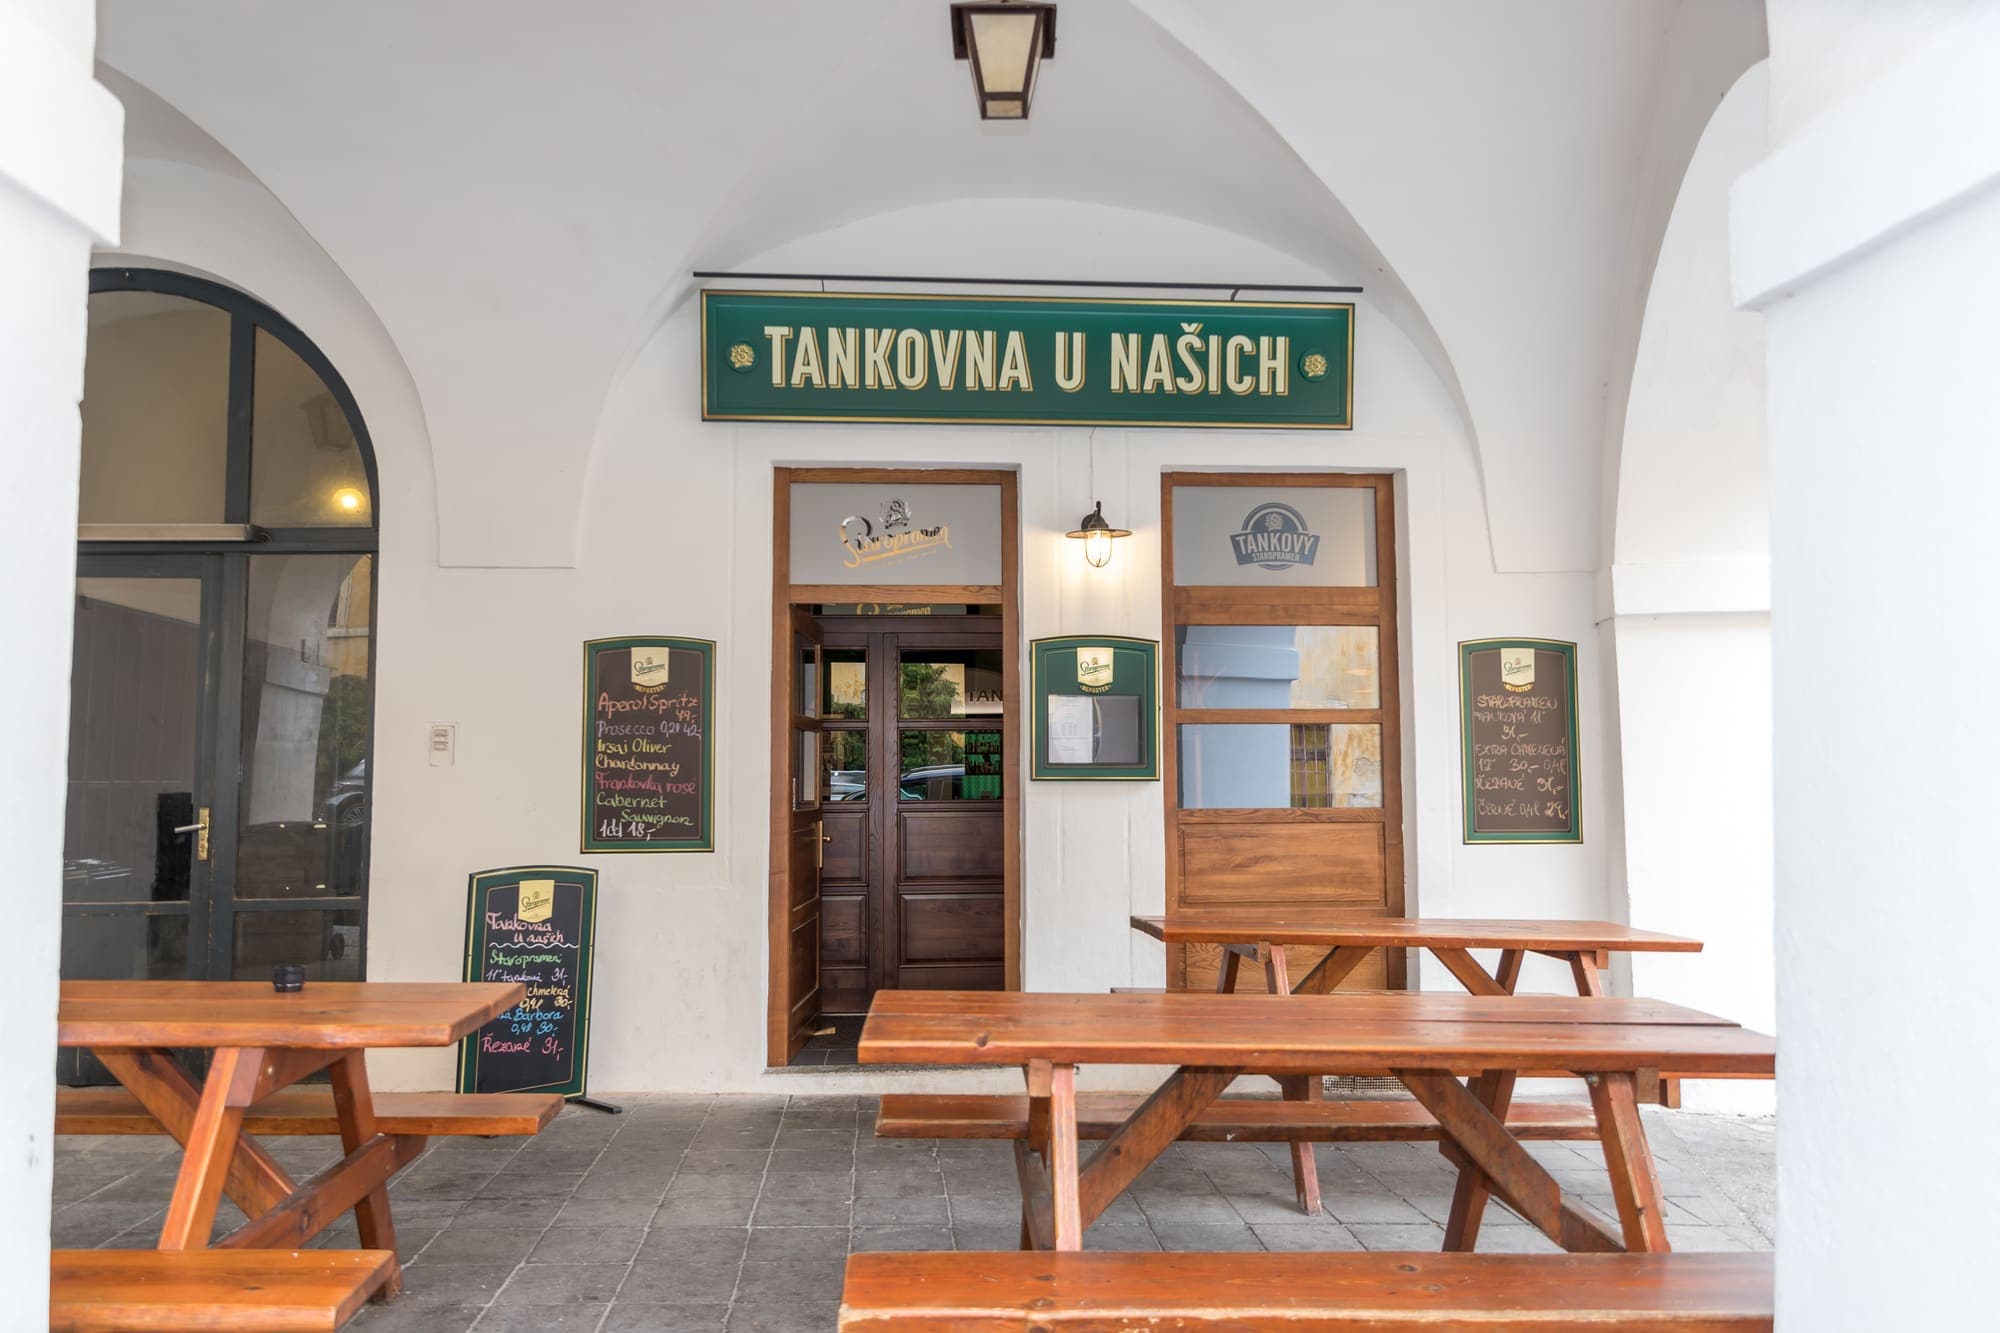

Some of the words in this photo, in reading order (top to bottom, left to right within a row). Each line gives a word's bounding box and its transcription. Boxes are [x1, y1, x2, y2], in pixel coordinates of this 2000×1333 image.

[764, 326, 1033, 392] TANKOVNA
[1055, 331, 1086, 392] U
[1110, 322, 1289, 396] NAŠICH
[1252, 551, 1300, 562] STAROPRAMEN
[598, 692, 648, 719] Aperol
[648, 690, 698, 714] Spritz
[595, 720, 655, 738] Prosecco
[631, 738, 672, 754] Oliver
[1474, 744, 1507, 756] EXTRA
[595, 753, 680, 777] Chardonnay
[595, 771, 663, 794] Frankovka
[596, 791, 667, 808] Cabernet
[621, 809, 695, 829] Sauvignon
[486, 912, 552, 932] Tankovna
[490, 949, 562, 968] Staropramen
[513, 1008, 564, 1021] Barbora
